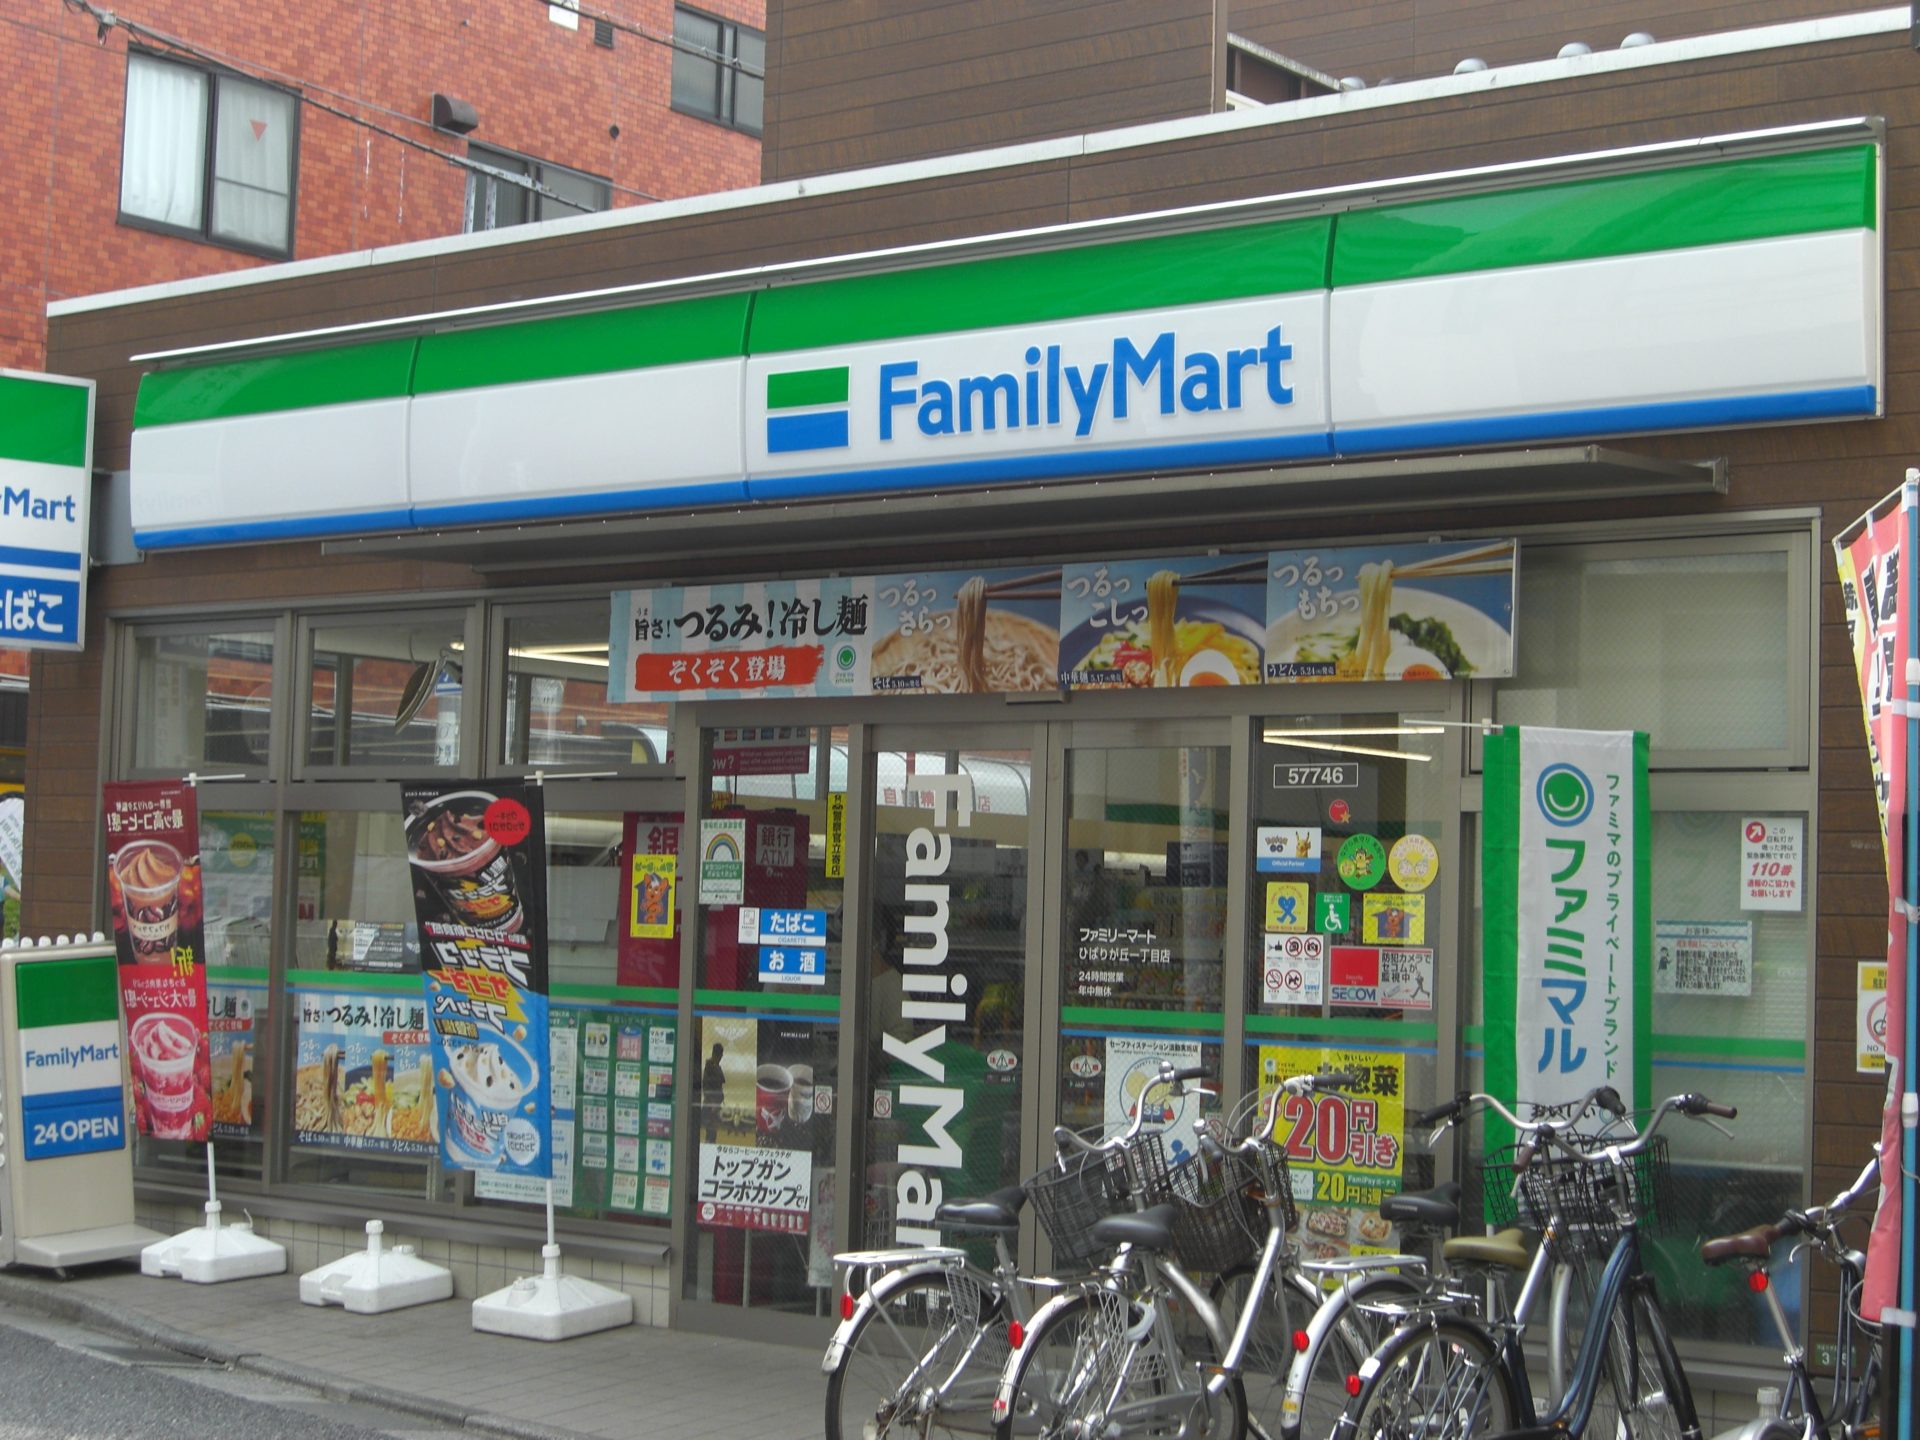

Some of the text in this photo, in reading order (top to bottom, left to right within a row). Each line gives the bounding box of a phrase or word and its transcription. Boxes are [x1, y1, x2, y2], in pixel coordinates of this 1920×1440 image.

[879, 322, 1295, 441] FamilyMart
[0, 486, 76, 523] Mart
[1067, 566, 1131, 598] つるっ
[1274, 556, 1344, 587] つるっ
[879, 578, 938, 607] つるっ
[1298, 588, 1360, 621] もちっ
[0, 589, 63, 633] ばこ
[900, 606, 951, 637] さらっ
[1090, 598, 1149, 628] こしっ
[669, 655, 787, 685] ぞくぞく登場
[1269, 664, 1297, 678] うどん
[873, 676, 891, 690] そば
[1288, 767, 1345, 785] 57746
[761, 825, 790, 849] 銀行
[1766, 835, 1794, 844] 回転灯が
[1772, 827, 1786, 835] この
[759, 850, 790, 865] ATM
[1751, 861, 1793, 877] 110番
[1746, 878, 1797, 888] 通報のご協力を
[1750, 889, 1793, 898] お願いします
[769, 911, 817, 935] たばこ
[1603, 773, 1622, 1080] ファミマのプライベートブランド
[1079, 927, 1157, 945] ファミリーマート
[1078, 947, 1171, 963] ひばりが丘一丁目店
[1381, 952, 1432, 964] 防犯カメラで
[1538, 837, 1588, 1075] ファミマル
[1078, 970, 1124, 983] 24時間営業
[1381, 963, 1417, 973] セコムが
[1381, 972, 1411, 984] 監視中
[1078, 984, 1112, 997] 年中無休
[1331, 986, 1376, 1001] SECOM
[25, 1042, 119, 1069] FamilyMart
[1284, 1095, 1348, 1163] 20
[713, 1155, 791, 1182] トップガン
[702, 1179, 809, 1210] コラボカップで!
